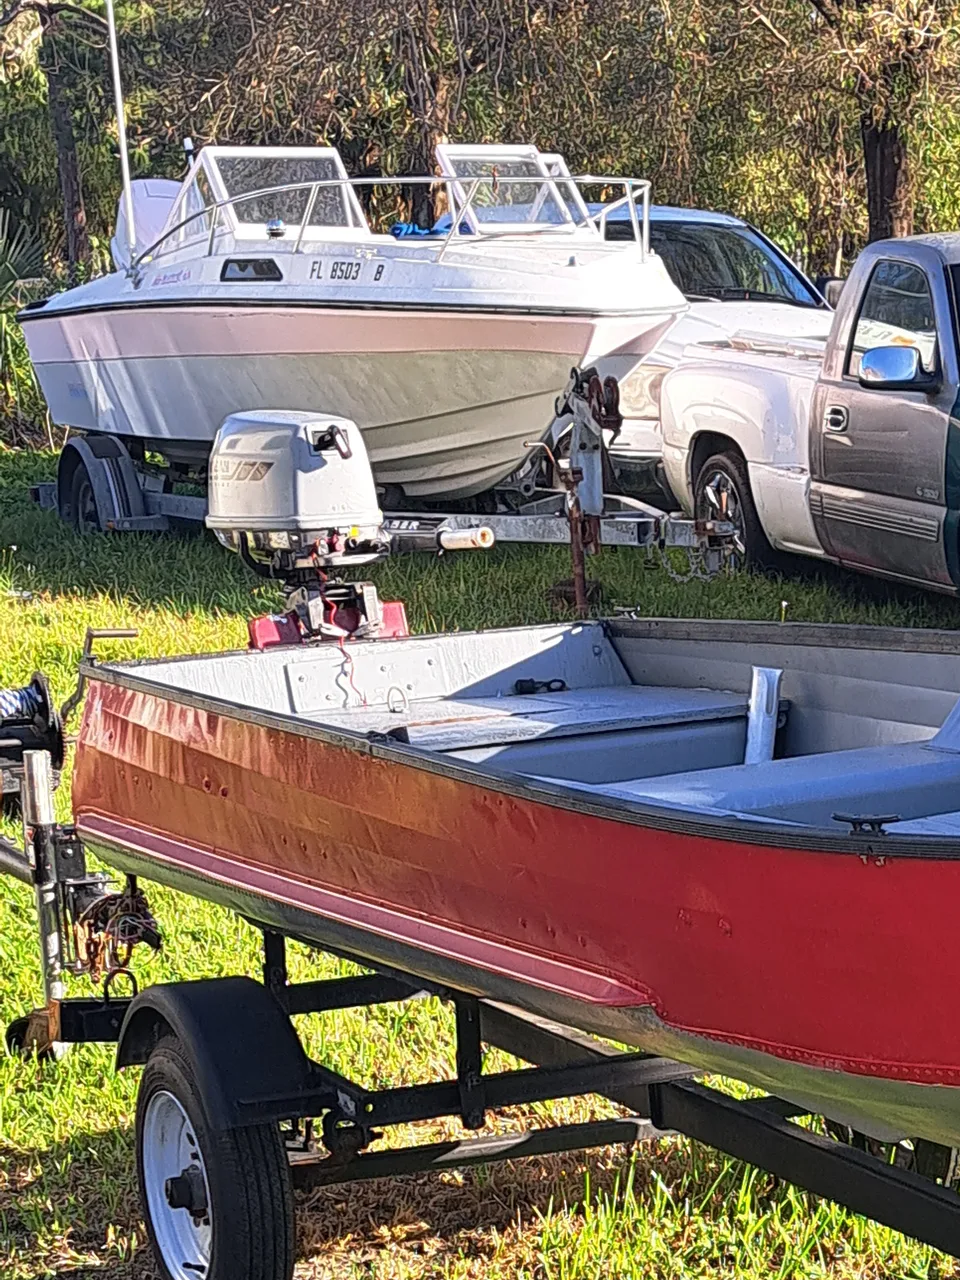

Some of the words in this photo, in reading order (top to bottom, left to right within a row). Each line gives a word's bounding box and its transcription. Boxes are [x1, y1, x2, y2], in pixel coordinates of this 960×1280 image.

[309, 261, 323, 279] FL
[330, 261, 361, 280] 8503
[373, 264, 385, 281] B
